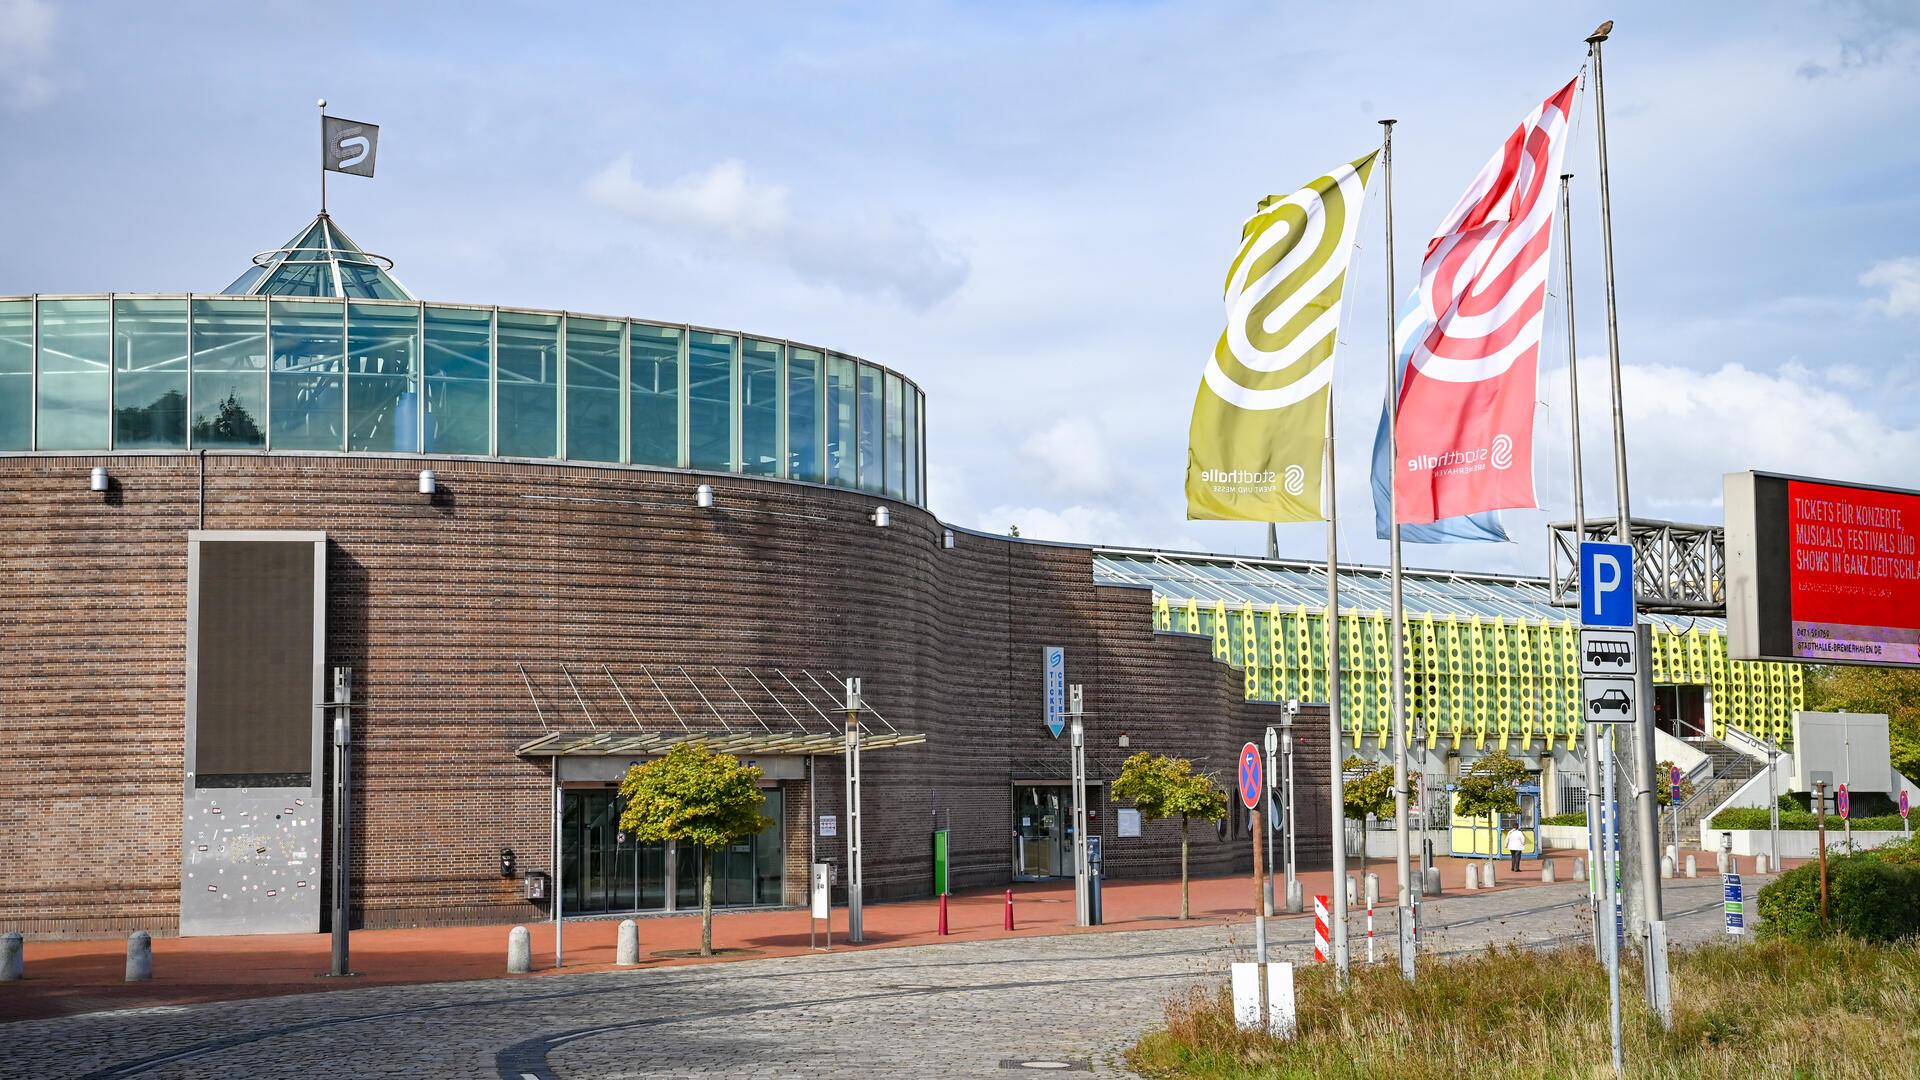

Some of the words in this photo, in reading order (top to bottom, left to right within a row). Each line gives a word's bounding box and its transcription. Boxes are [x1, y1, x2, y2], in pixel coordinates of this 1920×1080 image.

[1795, 498, 1834, 522] TICKETS
[1837, 500, 1854, 525] FÜR
[1856, 505, 1904, 533] KONZERTE,
[1796, 523, 1846, 553] MUSICALS,
[1848, 529, 1895, 553] FESTIVALS
[1897, 534, 1915, 555] UND
[1797, 549, 1829, 572] SHOWS
[1832, 552, 1841, 573] IN
[1844, 553, 1869, 576] GANZ
[1593, 553, 1622, 616] P
